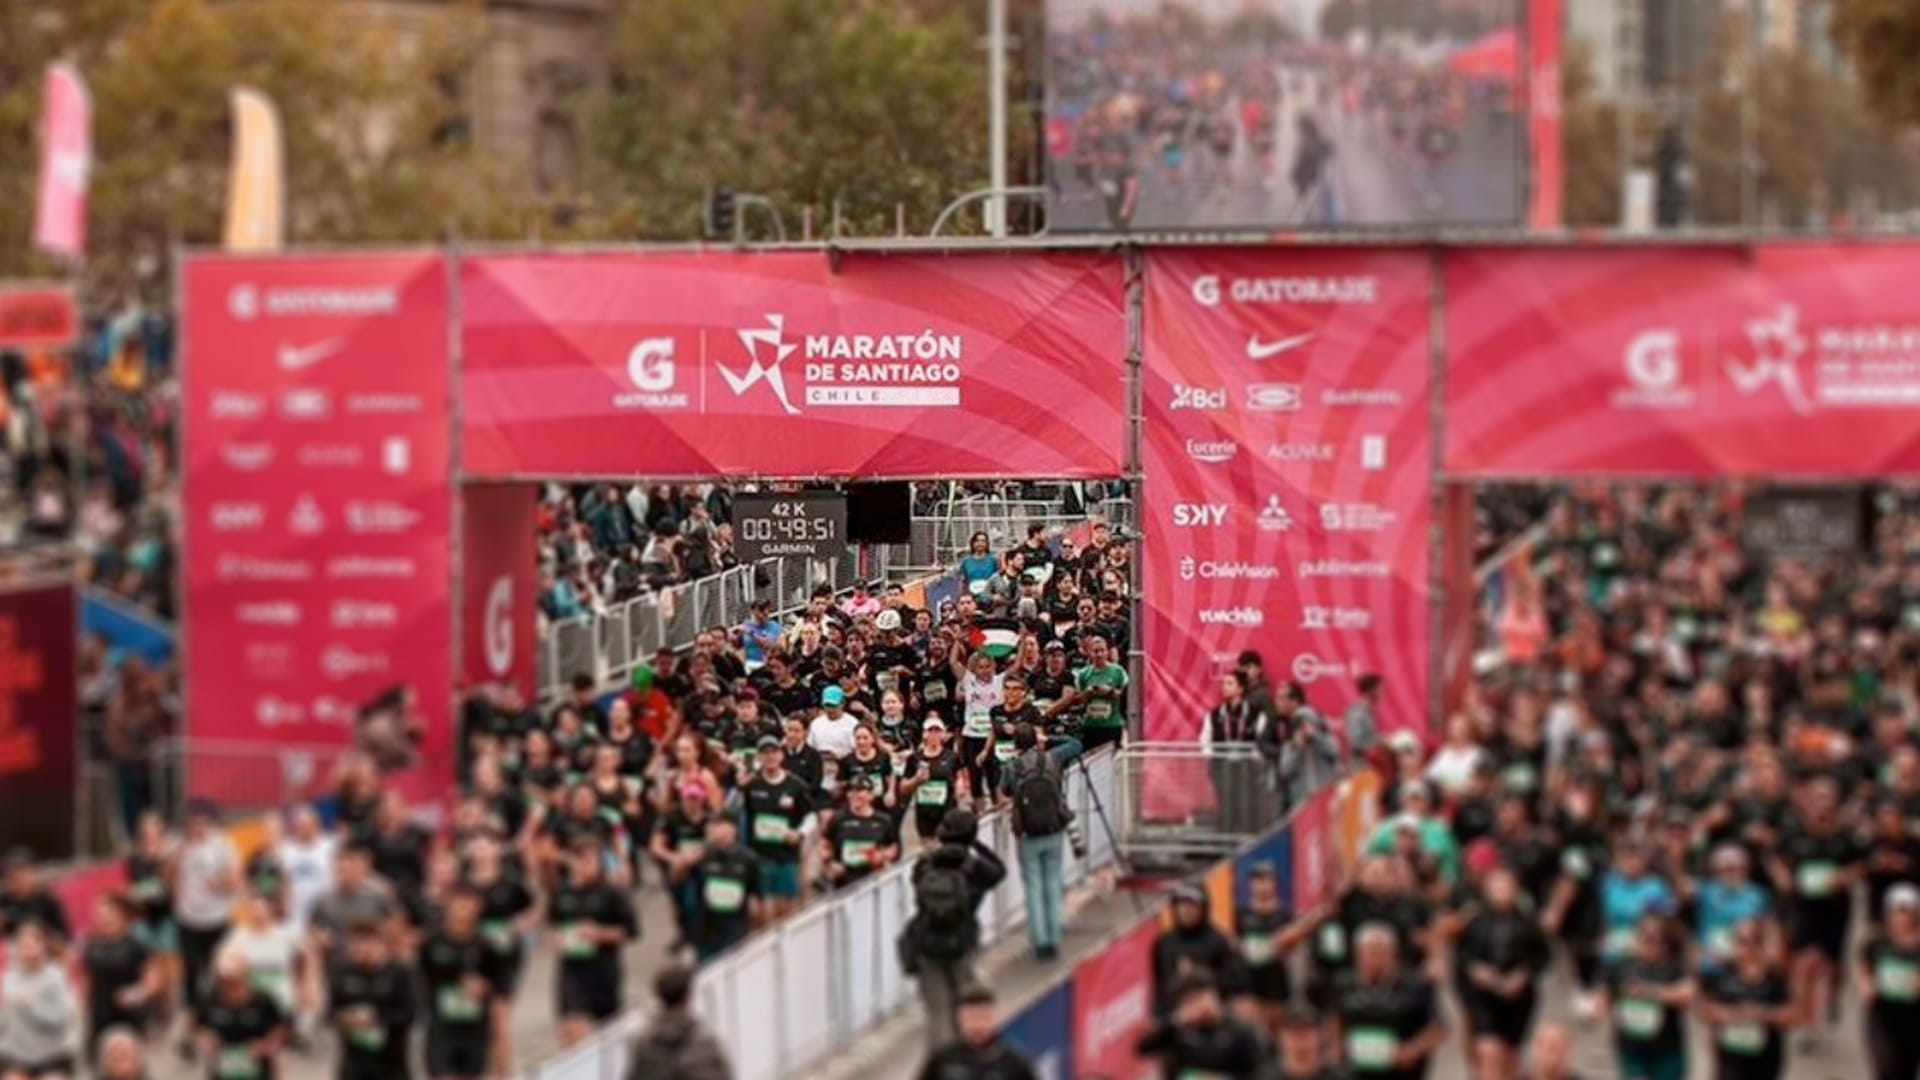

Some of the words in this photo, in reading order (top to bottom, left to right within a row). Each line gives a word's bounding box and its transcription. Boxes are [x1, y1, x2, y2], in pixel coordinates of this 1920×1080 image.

[805, 329, 961, 359] MARATÓN
[805, 364, 835, 381] DE
[841, 363, 960, 381] SANTIAGO
[811, 390, 881, 401] CHILE
[1186, 439, 1237, 455] Eucerin
[771, 502, 790, 517] 42
[793, 502, 806, 517] K
[742, 517, 835, 541] 00:49:51
[761, 543, 816, 555] GARMIN
